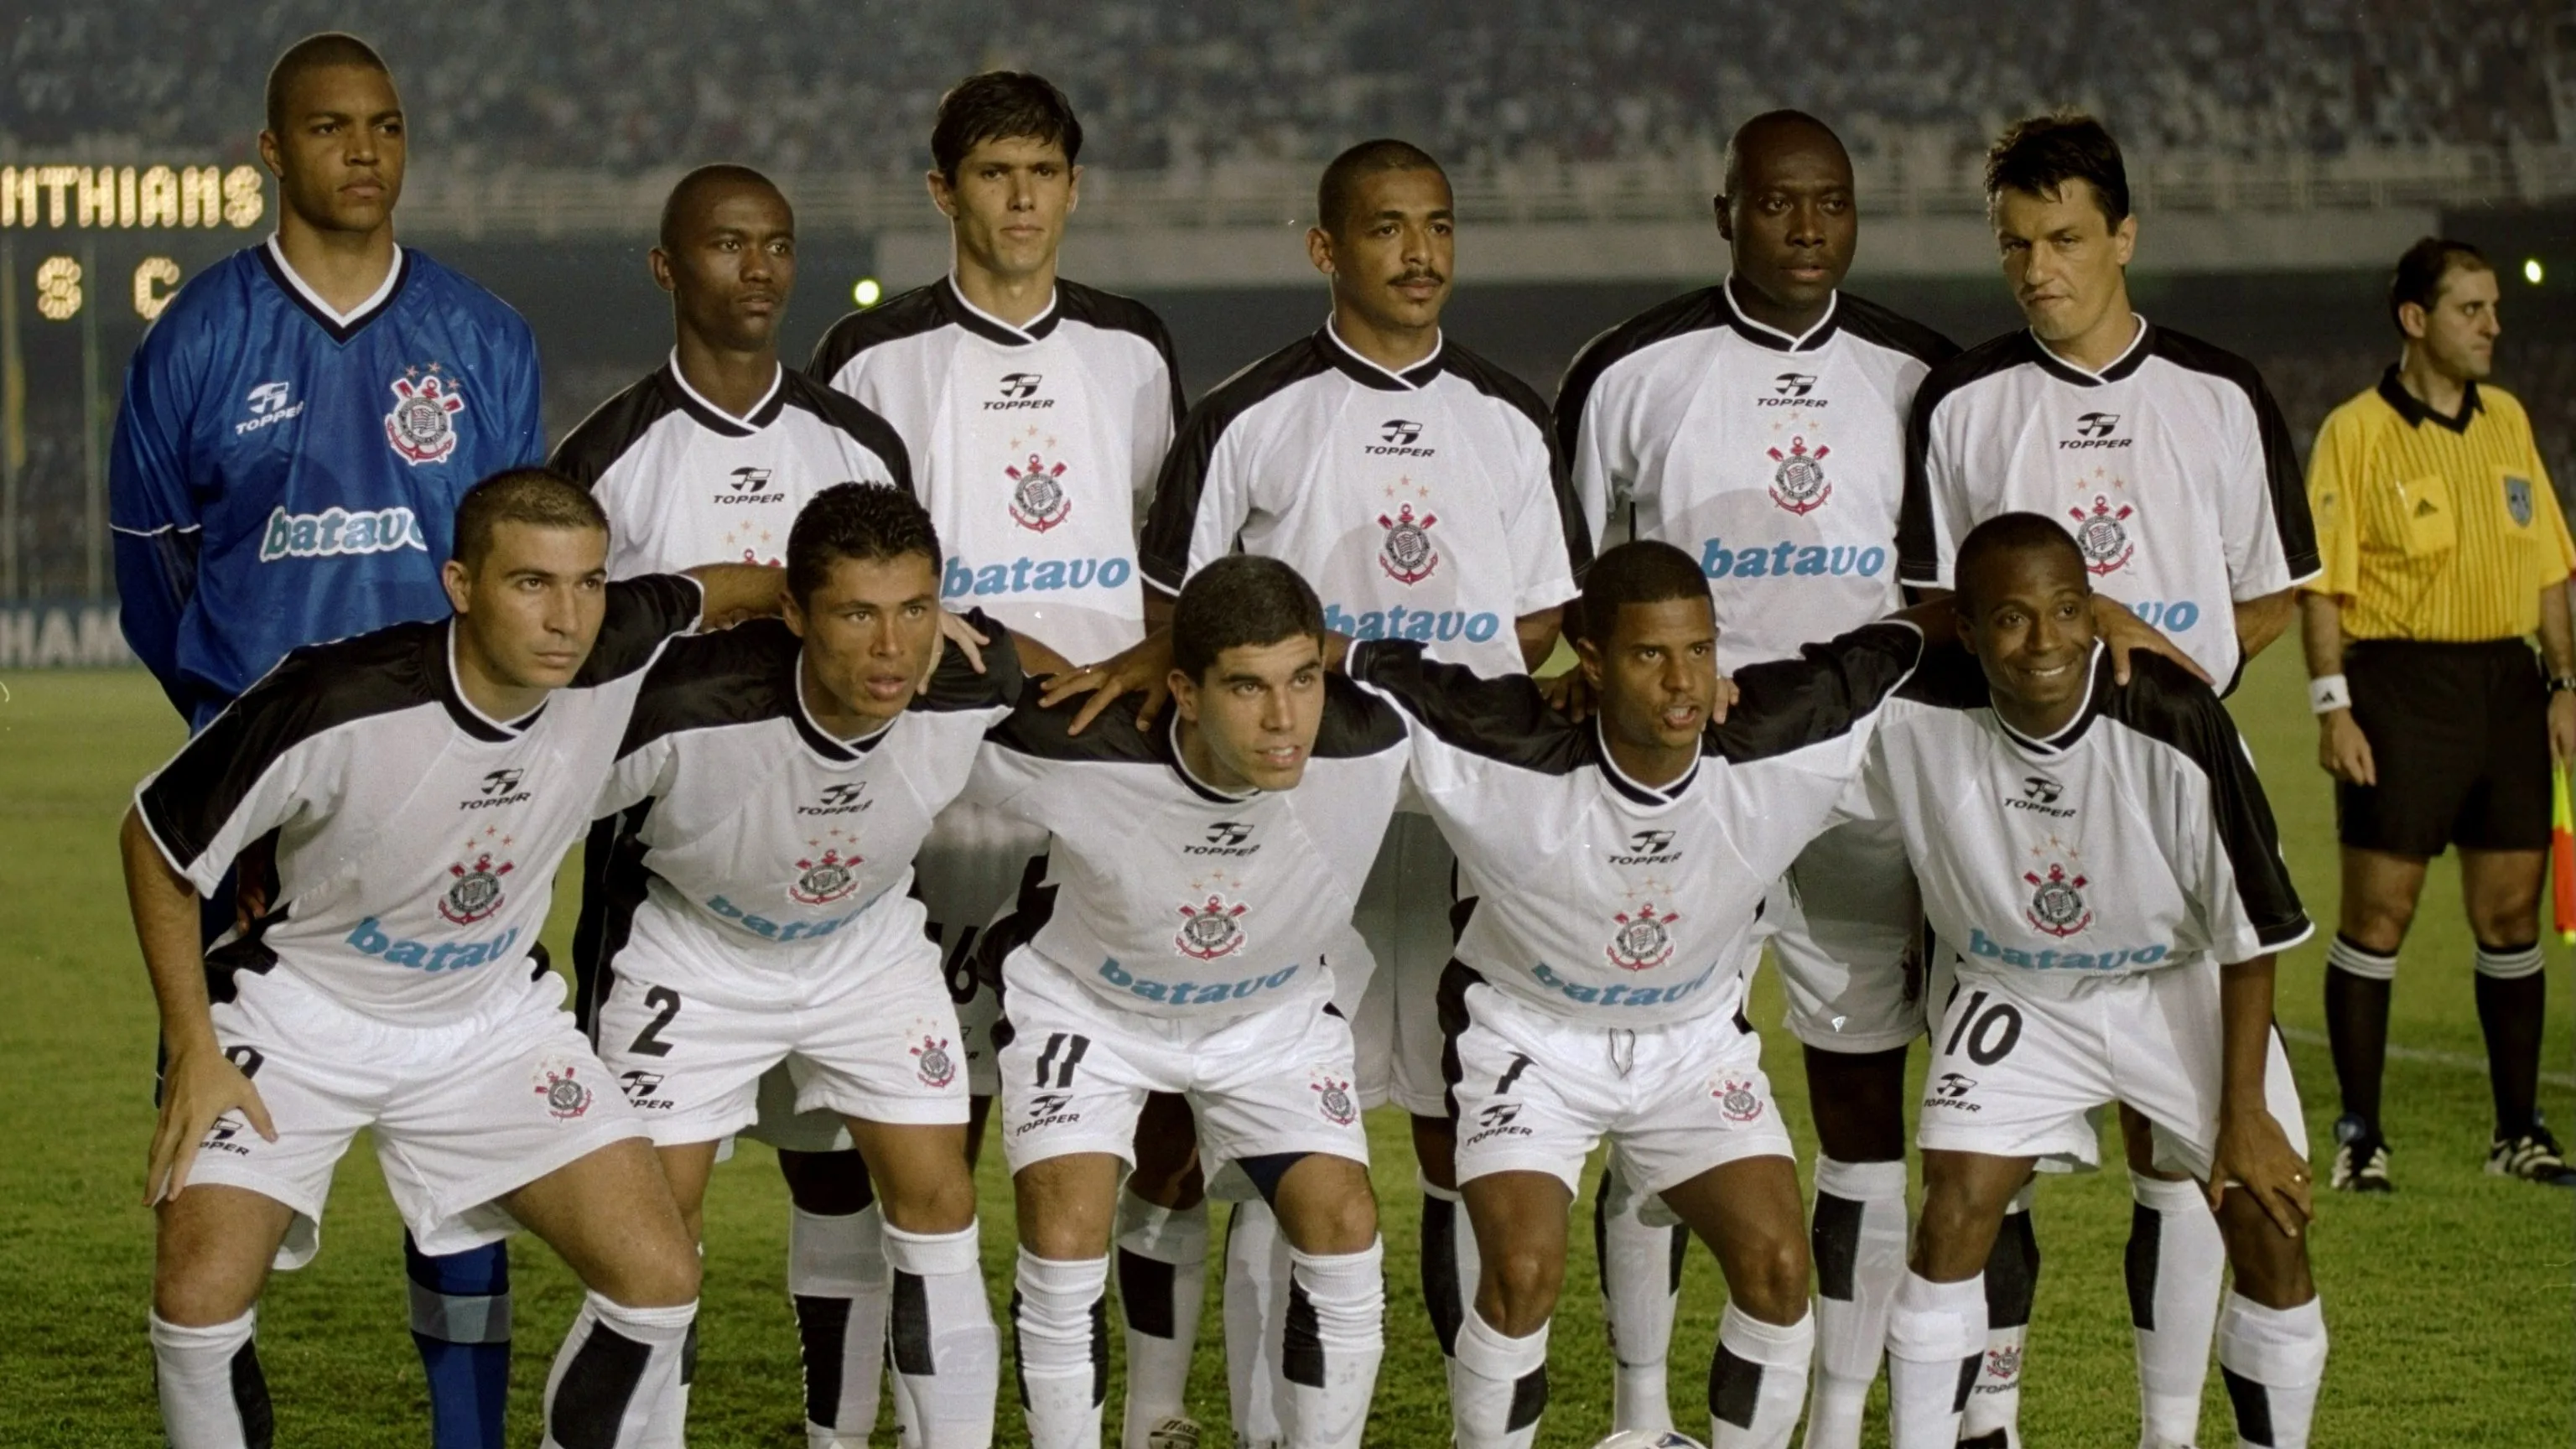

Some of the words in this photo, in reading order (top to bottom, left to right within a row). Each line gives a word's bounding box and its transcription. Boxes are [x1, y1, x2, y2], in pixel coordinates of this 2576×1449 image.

[983, 399, 1055, 411] TOPPER
[1757, 398, 1829, 408] TOPPER
[1364, 445, 1436, 458] TOPPER
[2059, 439, 2132, 450] TOPPER
[714, 493, 785, 505] TOPPER
[1702, 538, 1885, 579] batavo
[942, 556, 1130, 598] batavo
[1325, 604, 1499, 643] batavo
[2004, 797, 2076, 818] TOPPER
[345, 917, 519, 972] batav
[1969, 928, 2168, 970] batavo
[944, 926, 979, 1004] 6
[1098, 957, 1300, 1005] batavo
[628, 984, 681, 1057] 2
[1945, 990, 2023, 1066] 10
[1034, 1032, 1091, 1088] 11
[629, 1098, 674, 1109] PER
[1924, 1098, 1981, 1113] TOPPER
[1016, 1113, 1080, 1137] TOPPER
[1467, 1126, 1533, 1146] TOPPER
[199, 1140, 250, 1156] PPER
